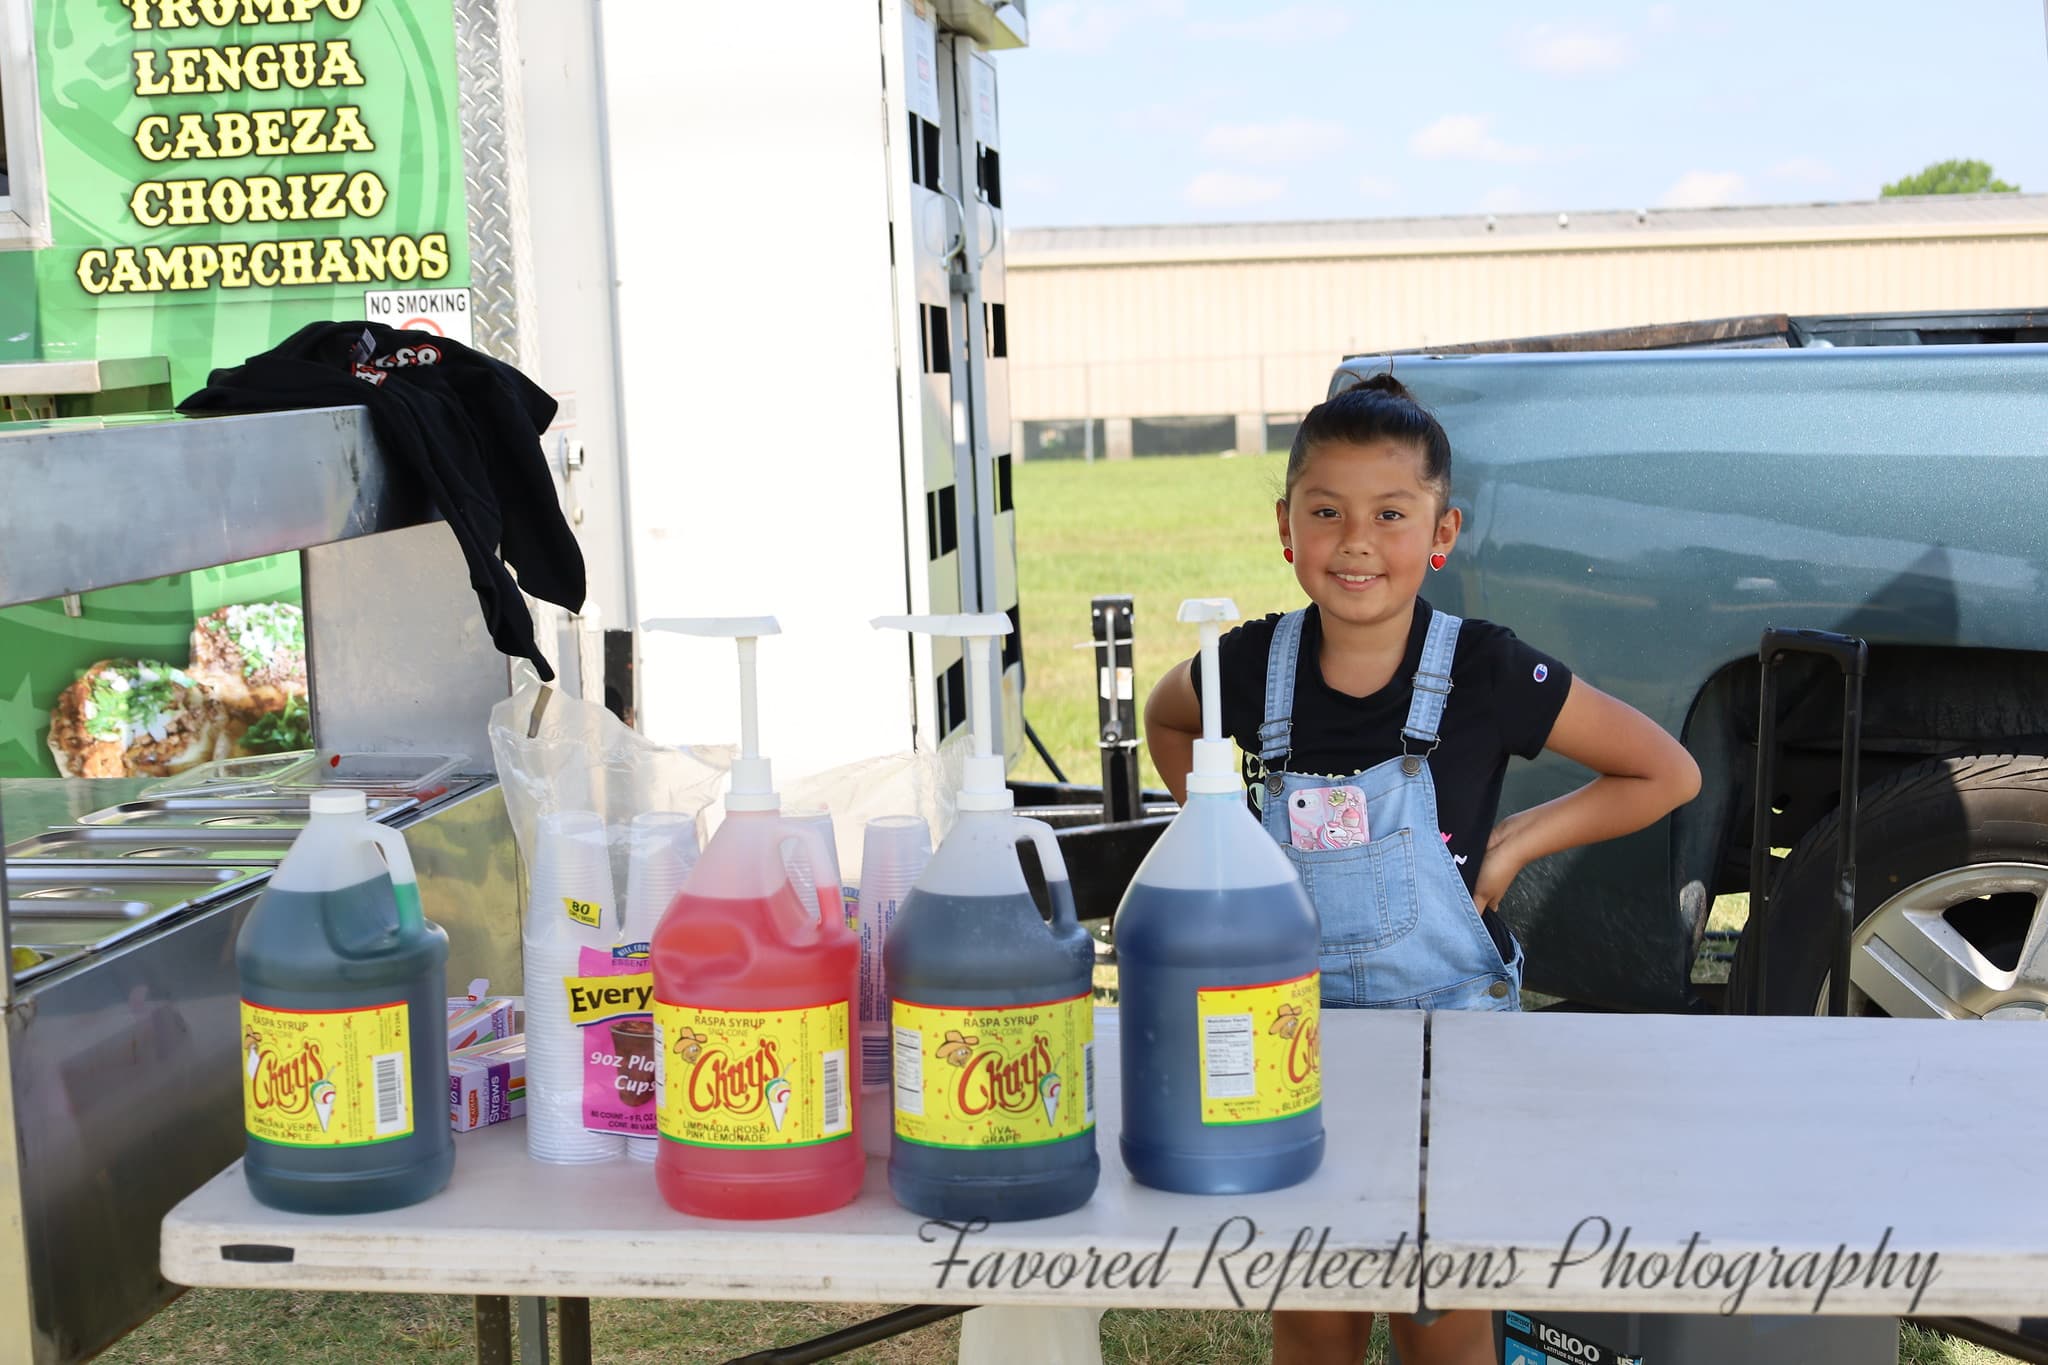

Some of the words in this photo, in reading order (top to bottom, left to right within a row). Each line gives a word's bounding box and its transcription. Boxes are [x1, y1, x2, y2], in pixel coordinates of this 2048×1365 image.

[133, 40, 366, 96] LENGUA
[133, 106, 376, 161] CABEZA
[130, 171, 388, 226] CHORIZO
[76, 233, 450, 294] CAMPECHANOS
[371, 296, 391, 314] NO
[397, 294, 466, 314] SMOKING
[571, 900, 591, 915] 80
[570, 986, 654, 1013] Every
[694, 1015, 726, 1027] RASPA
[729, 1018, 766, 1029] SYRUP
[964, 1018, 1001, 1028] RASPA
[1004, 1014, 1040, 1027] SYRUP
[590, 1051, 624, 1068] 9oz
[614, 1075, 657, 1096] Cups
[489, 1075, 500, 1123] Straws
[683, 1121, 730, 1133] LIMONADA
[733, 1125, 770, 1134] (ROSA)
[686, 1130, 705, 1139] PINK
[708, 1133, 766, 1143] LEMONADE
[989, 1125, 1013, 1136] UVA
[981, 1135, 1018, 1145] GRAPE
[1540, 1324, 1600, 1362] IGLOO
